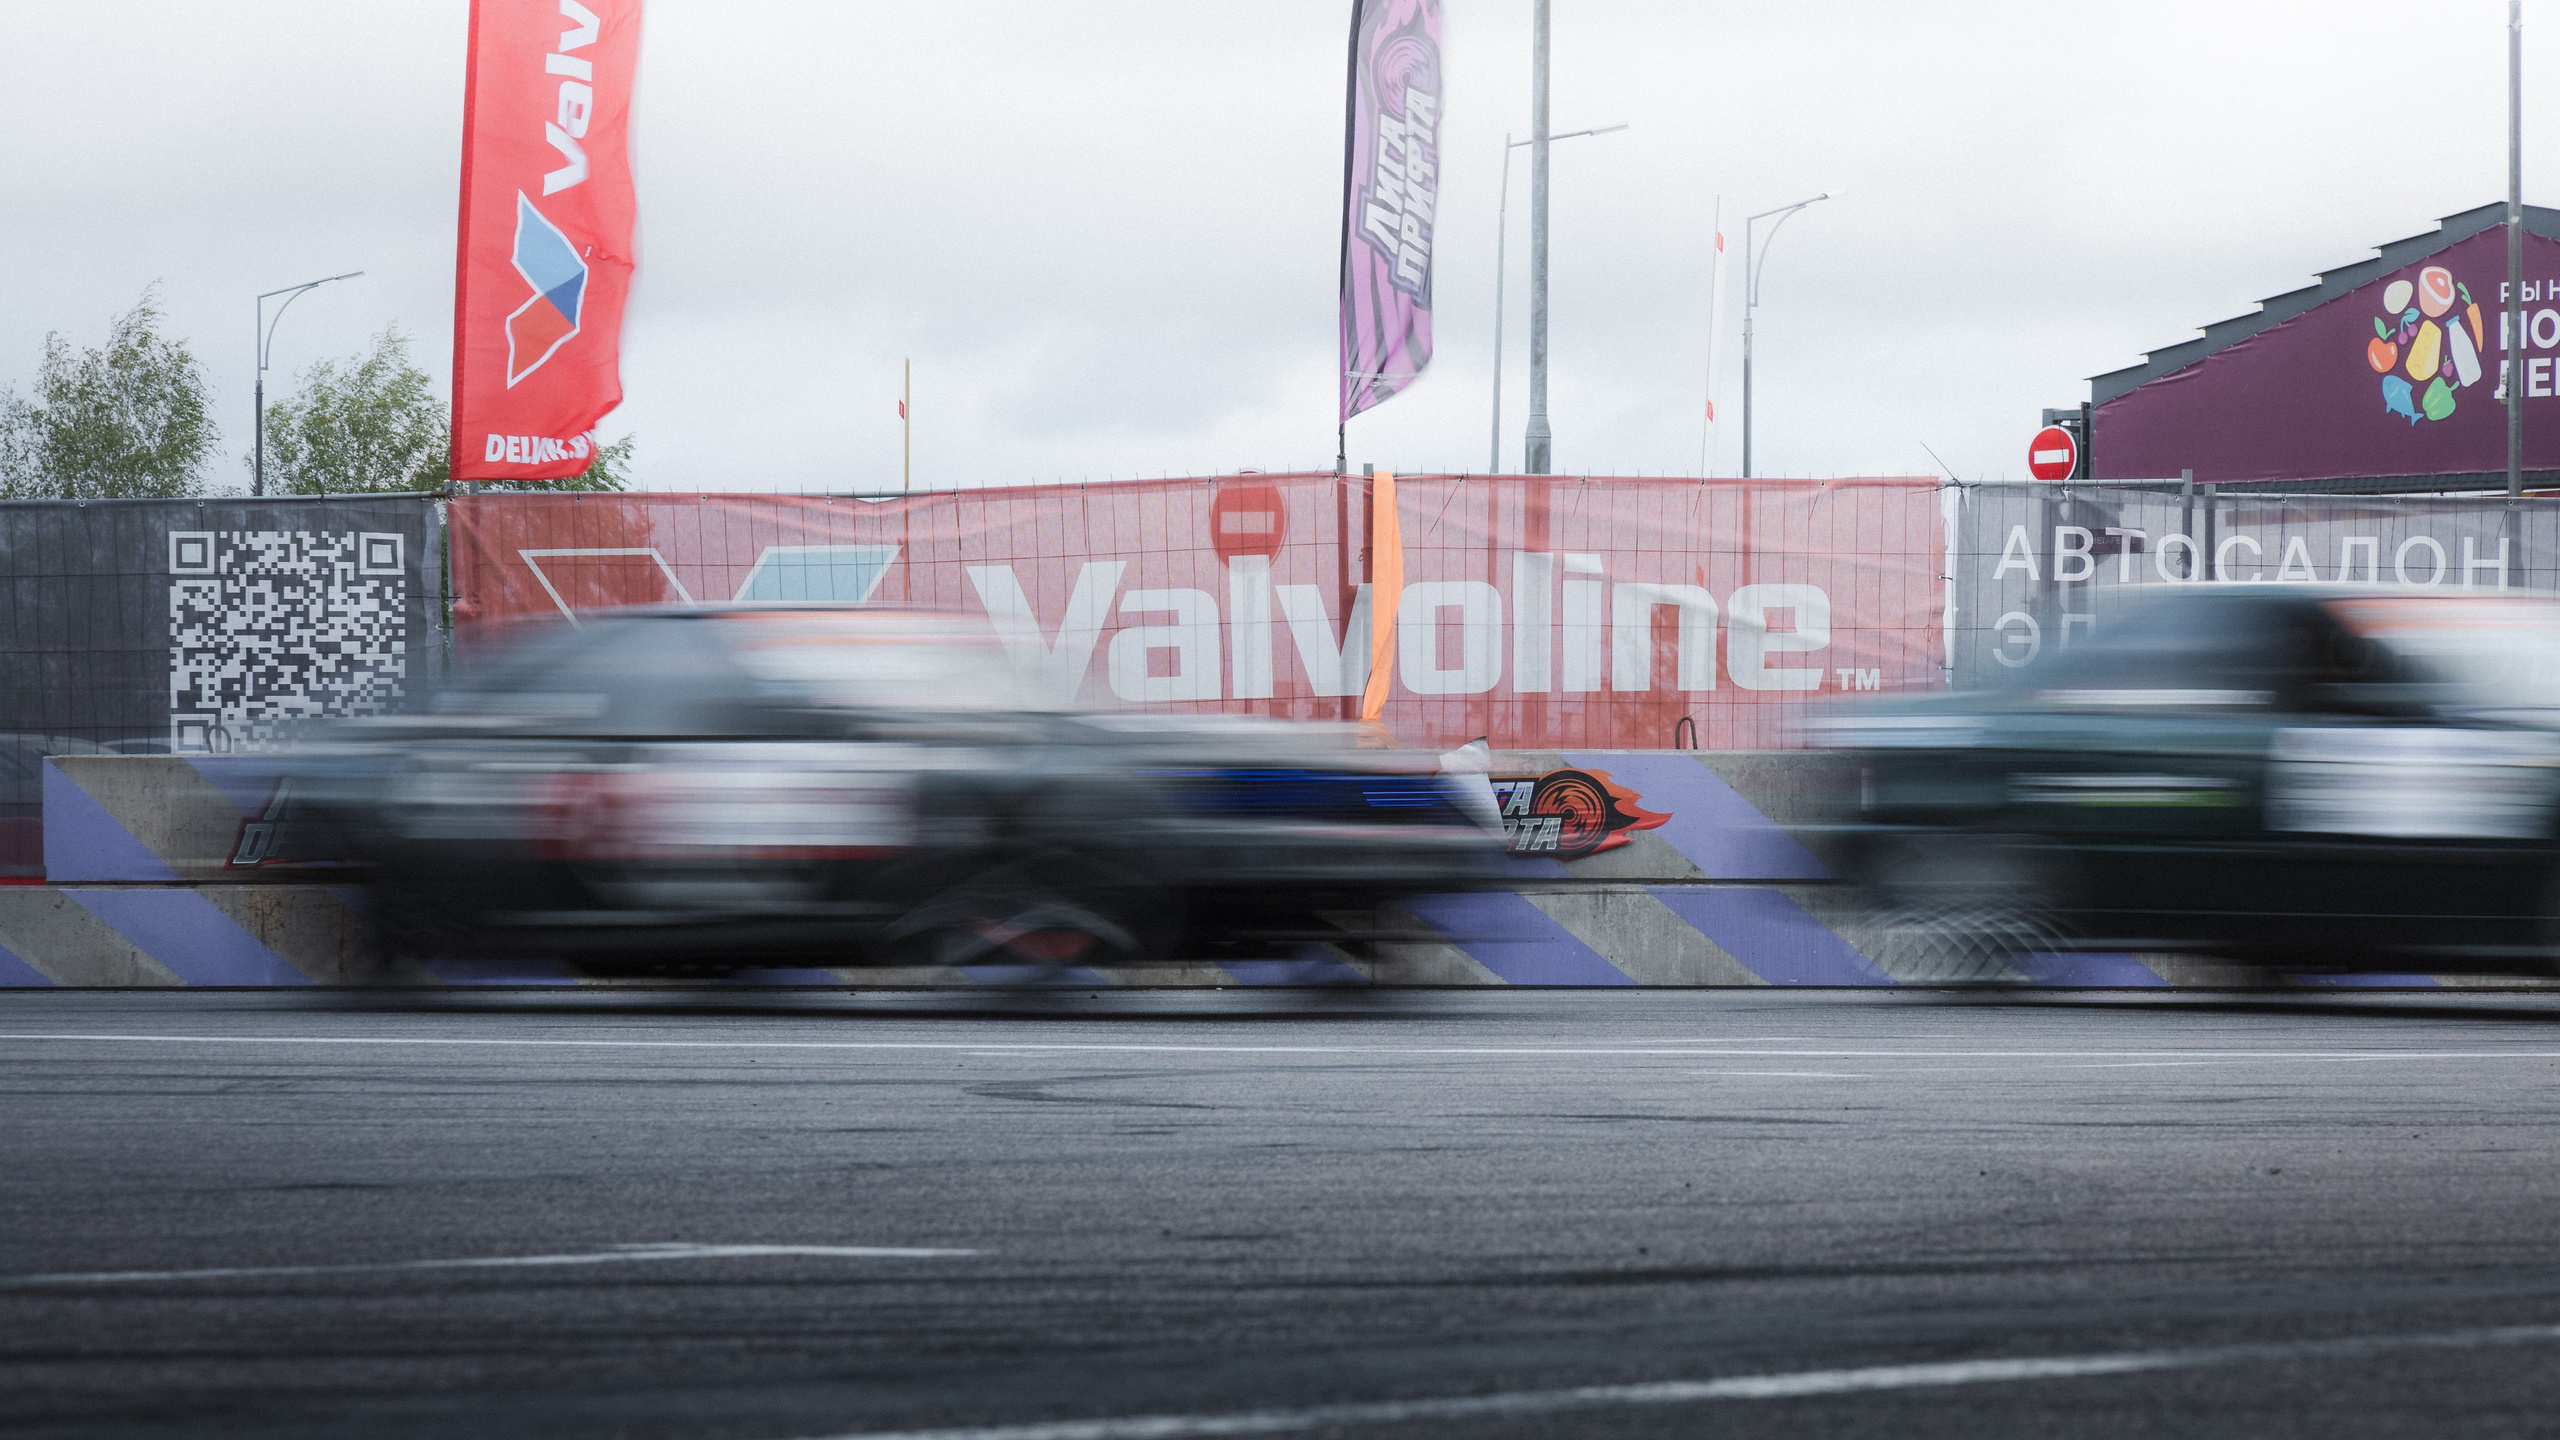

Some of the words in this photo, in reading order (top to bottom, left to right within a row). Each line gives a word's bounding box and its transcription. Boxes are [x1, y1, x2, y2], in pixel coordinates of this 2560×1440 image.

[1365, 114, 1407, 255] ЛИГА
[2493, 357, 2560, 400] ДЕ
[1992, 524, 2510, 592] АВТОСАЛОН
[964, 551, 1831, 702] Valvoline
